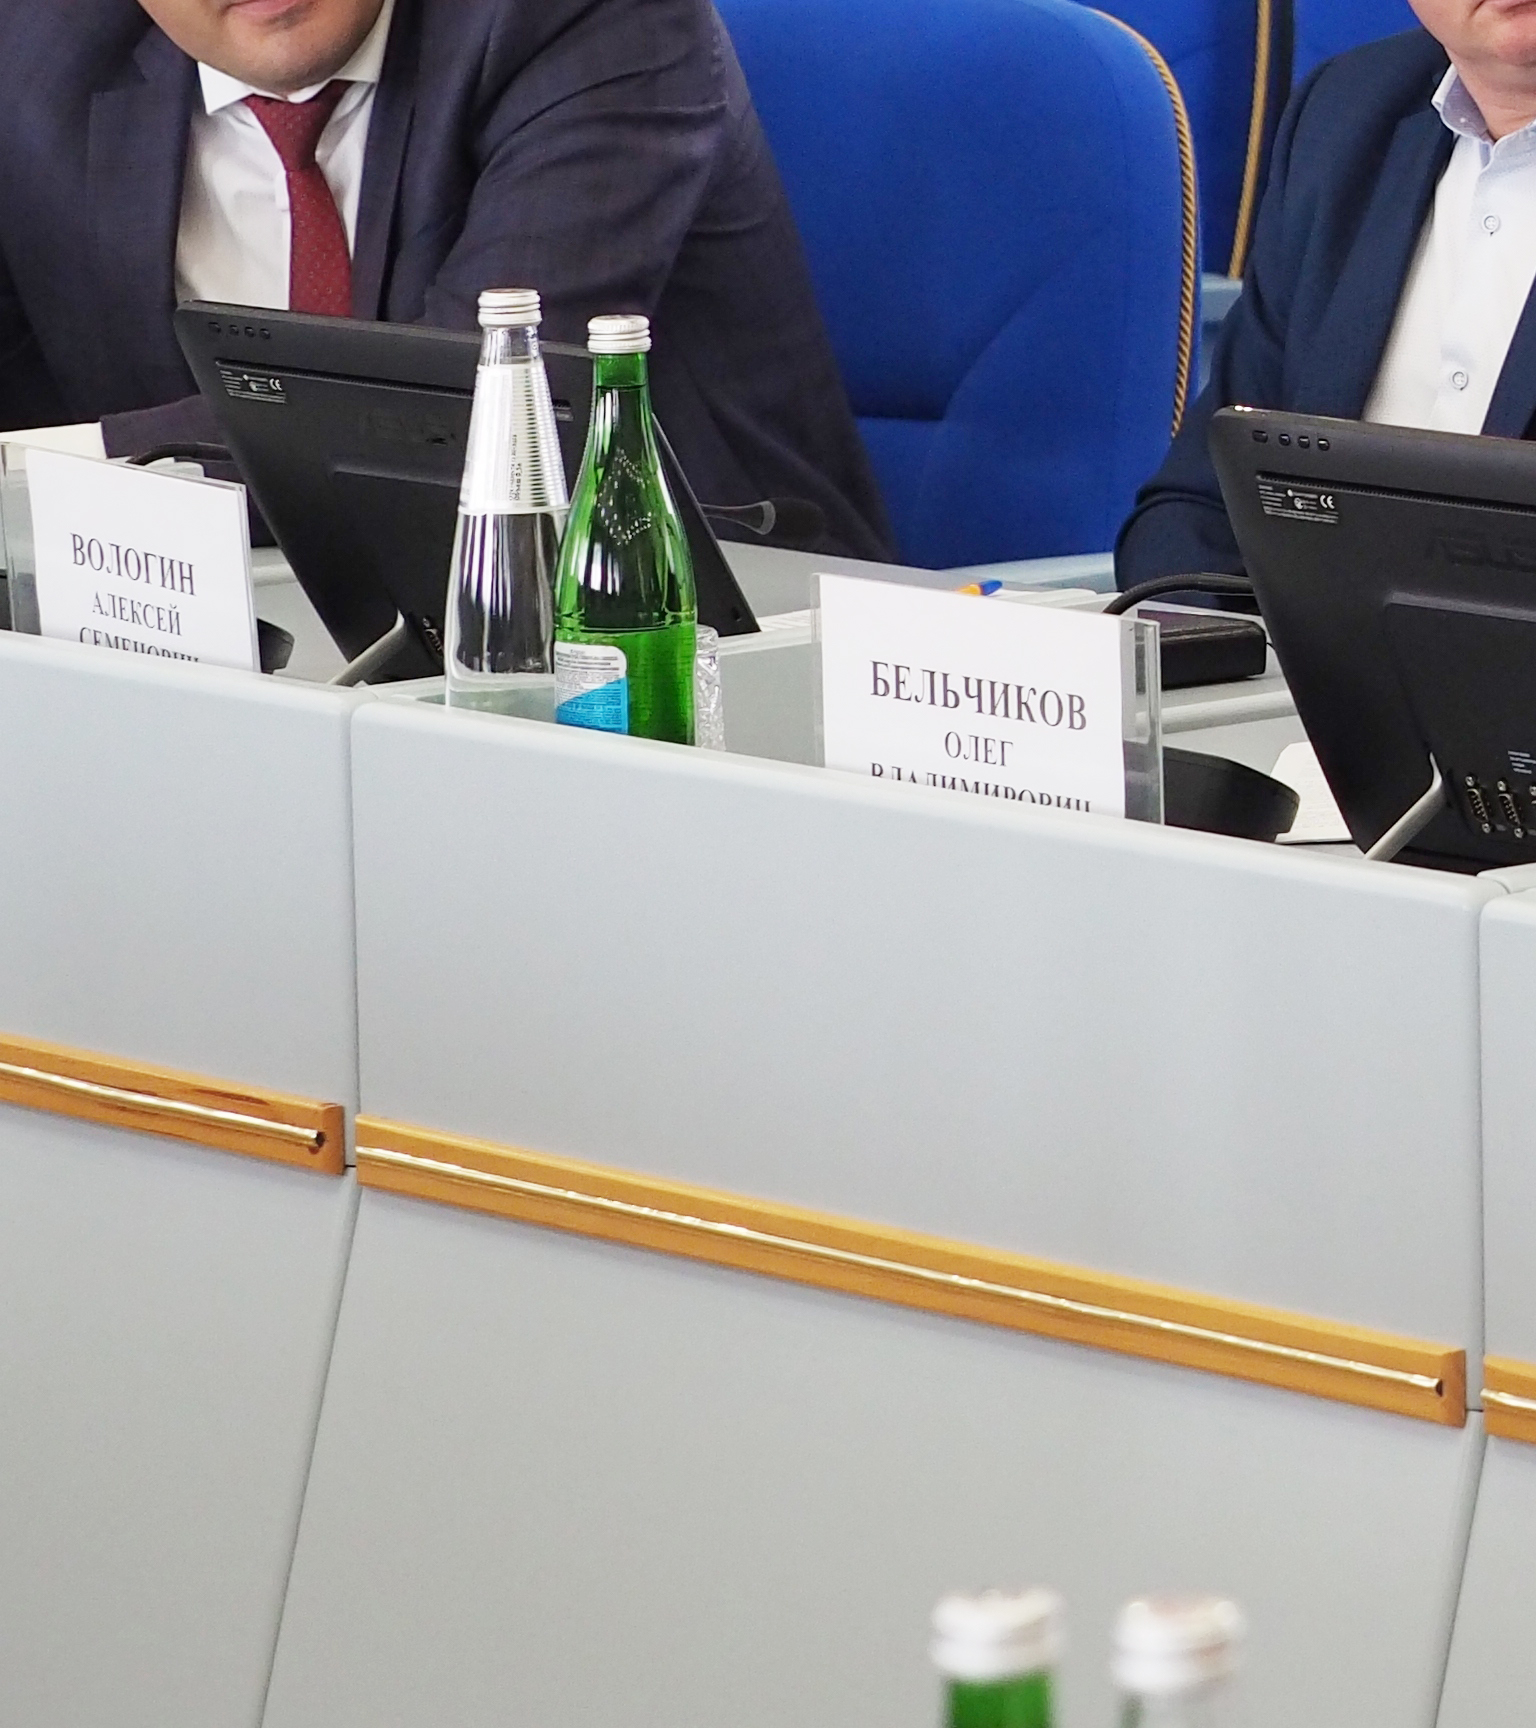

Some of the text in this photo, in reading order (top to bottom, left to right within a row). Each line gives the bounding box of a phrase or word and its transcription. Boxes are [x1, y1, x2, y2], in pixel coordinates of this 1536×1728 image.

[70, 532, 197, 597] ВОЛОГИН
[92, 590, 183, 637] АЛЕКСЕЙ
[869, 660, 1088, 731] БЕЛЬЧИКОВ
[944, 730, 1014, 767] ОЛЕГ
